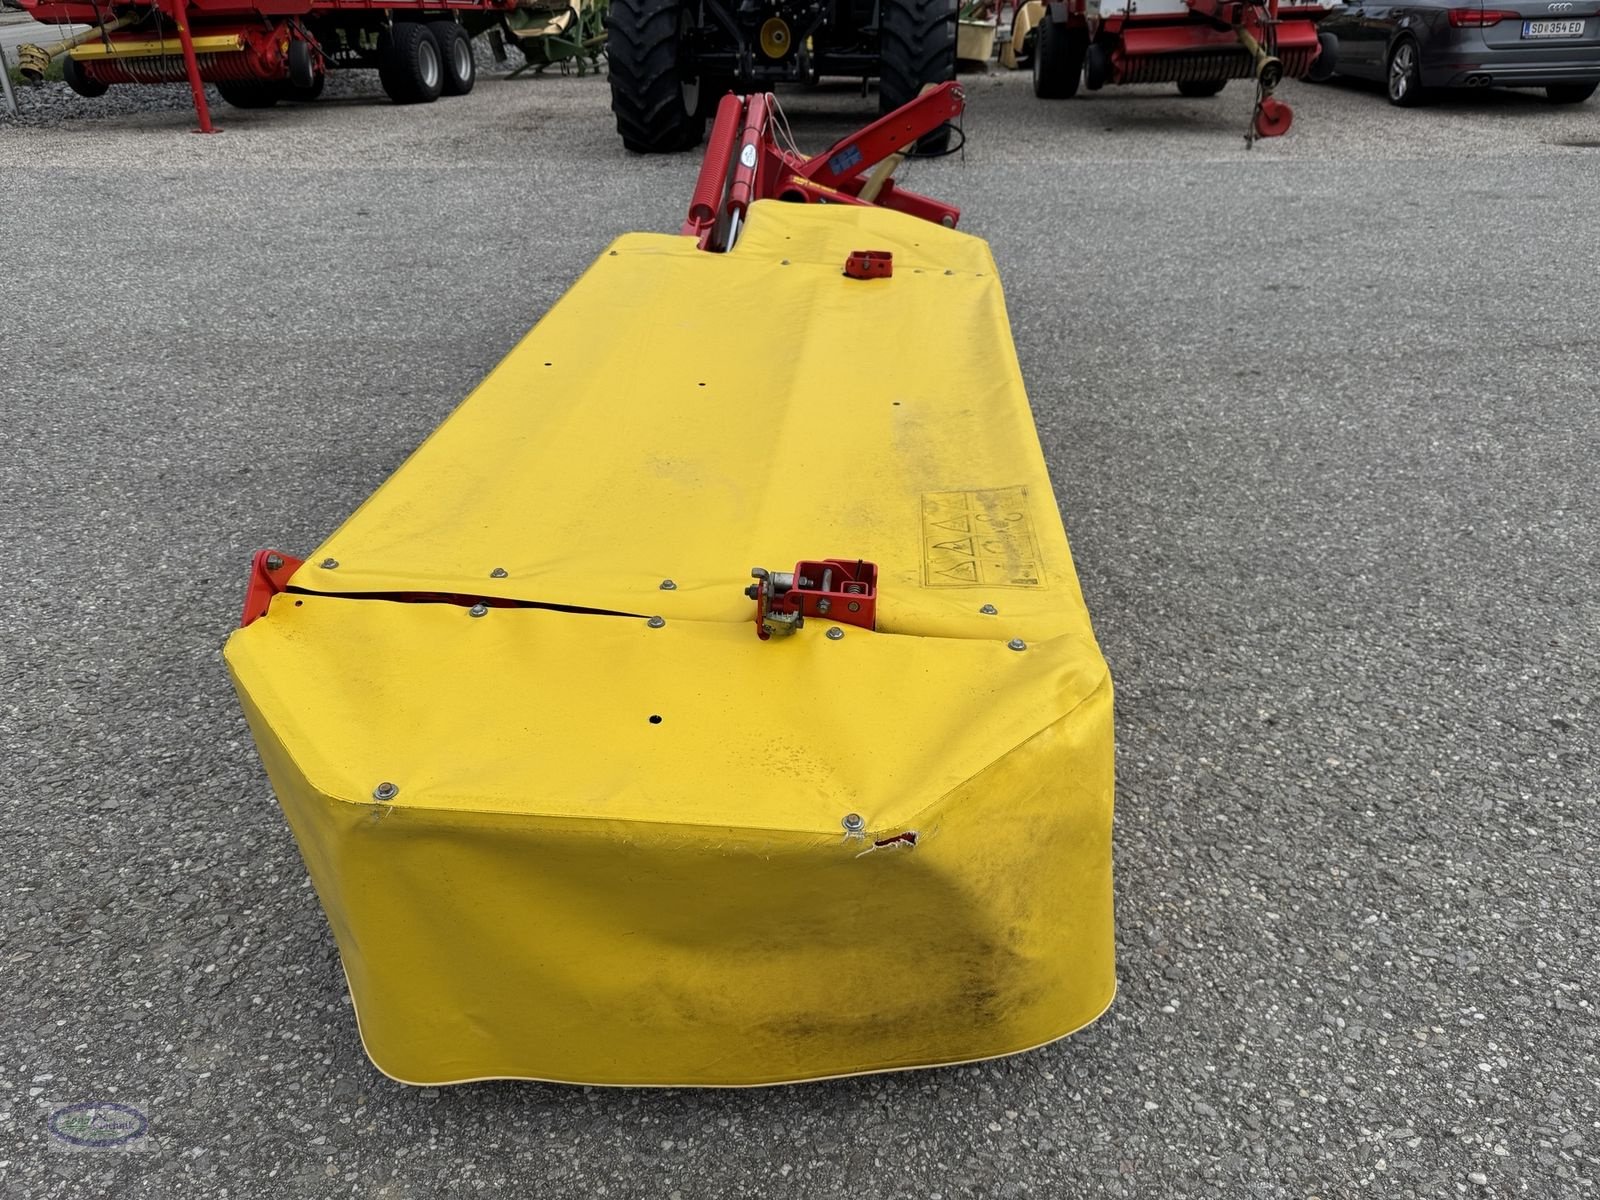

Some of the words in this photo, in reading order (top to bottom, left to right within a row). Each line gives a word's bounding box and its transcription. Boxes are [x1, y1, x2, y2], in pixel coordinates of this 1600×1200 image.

[1531, 23, 1544, 33] SD
[1549, 22, 1567, 33] 354
[1568, 22, 1582, 32] ED
